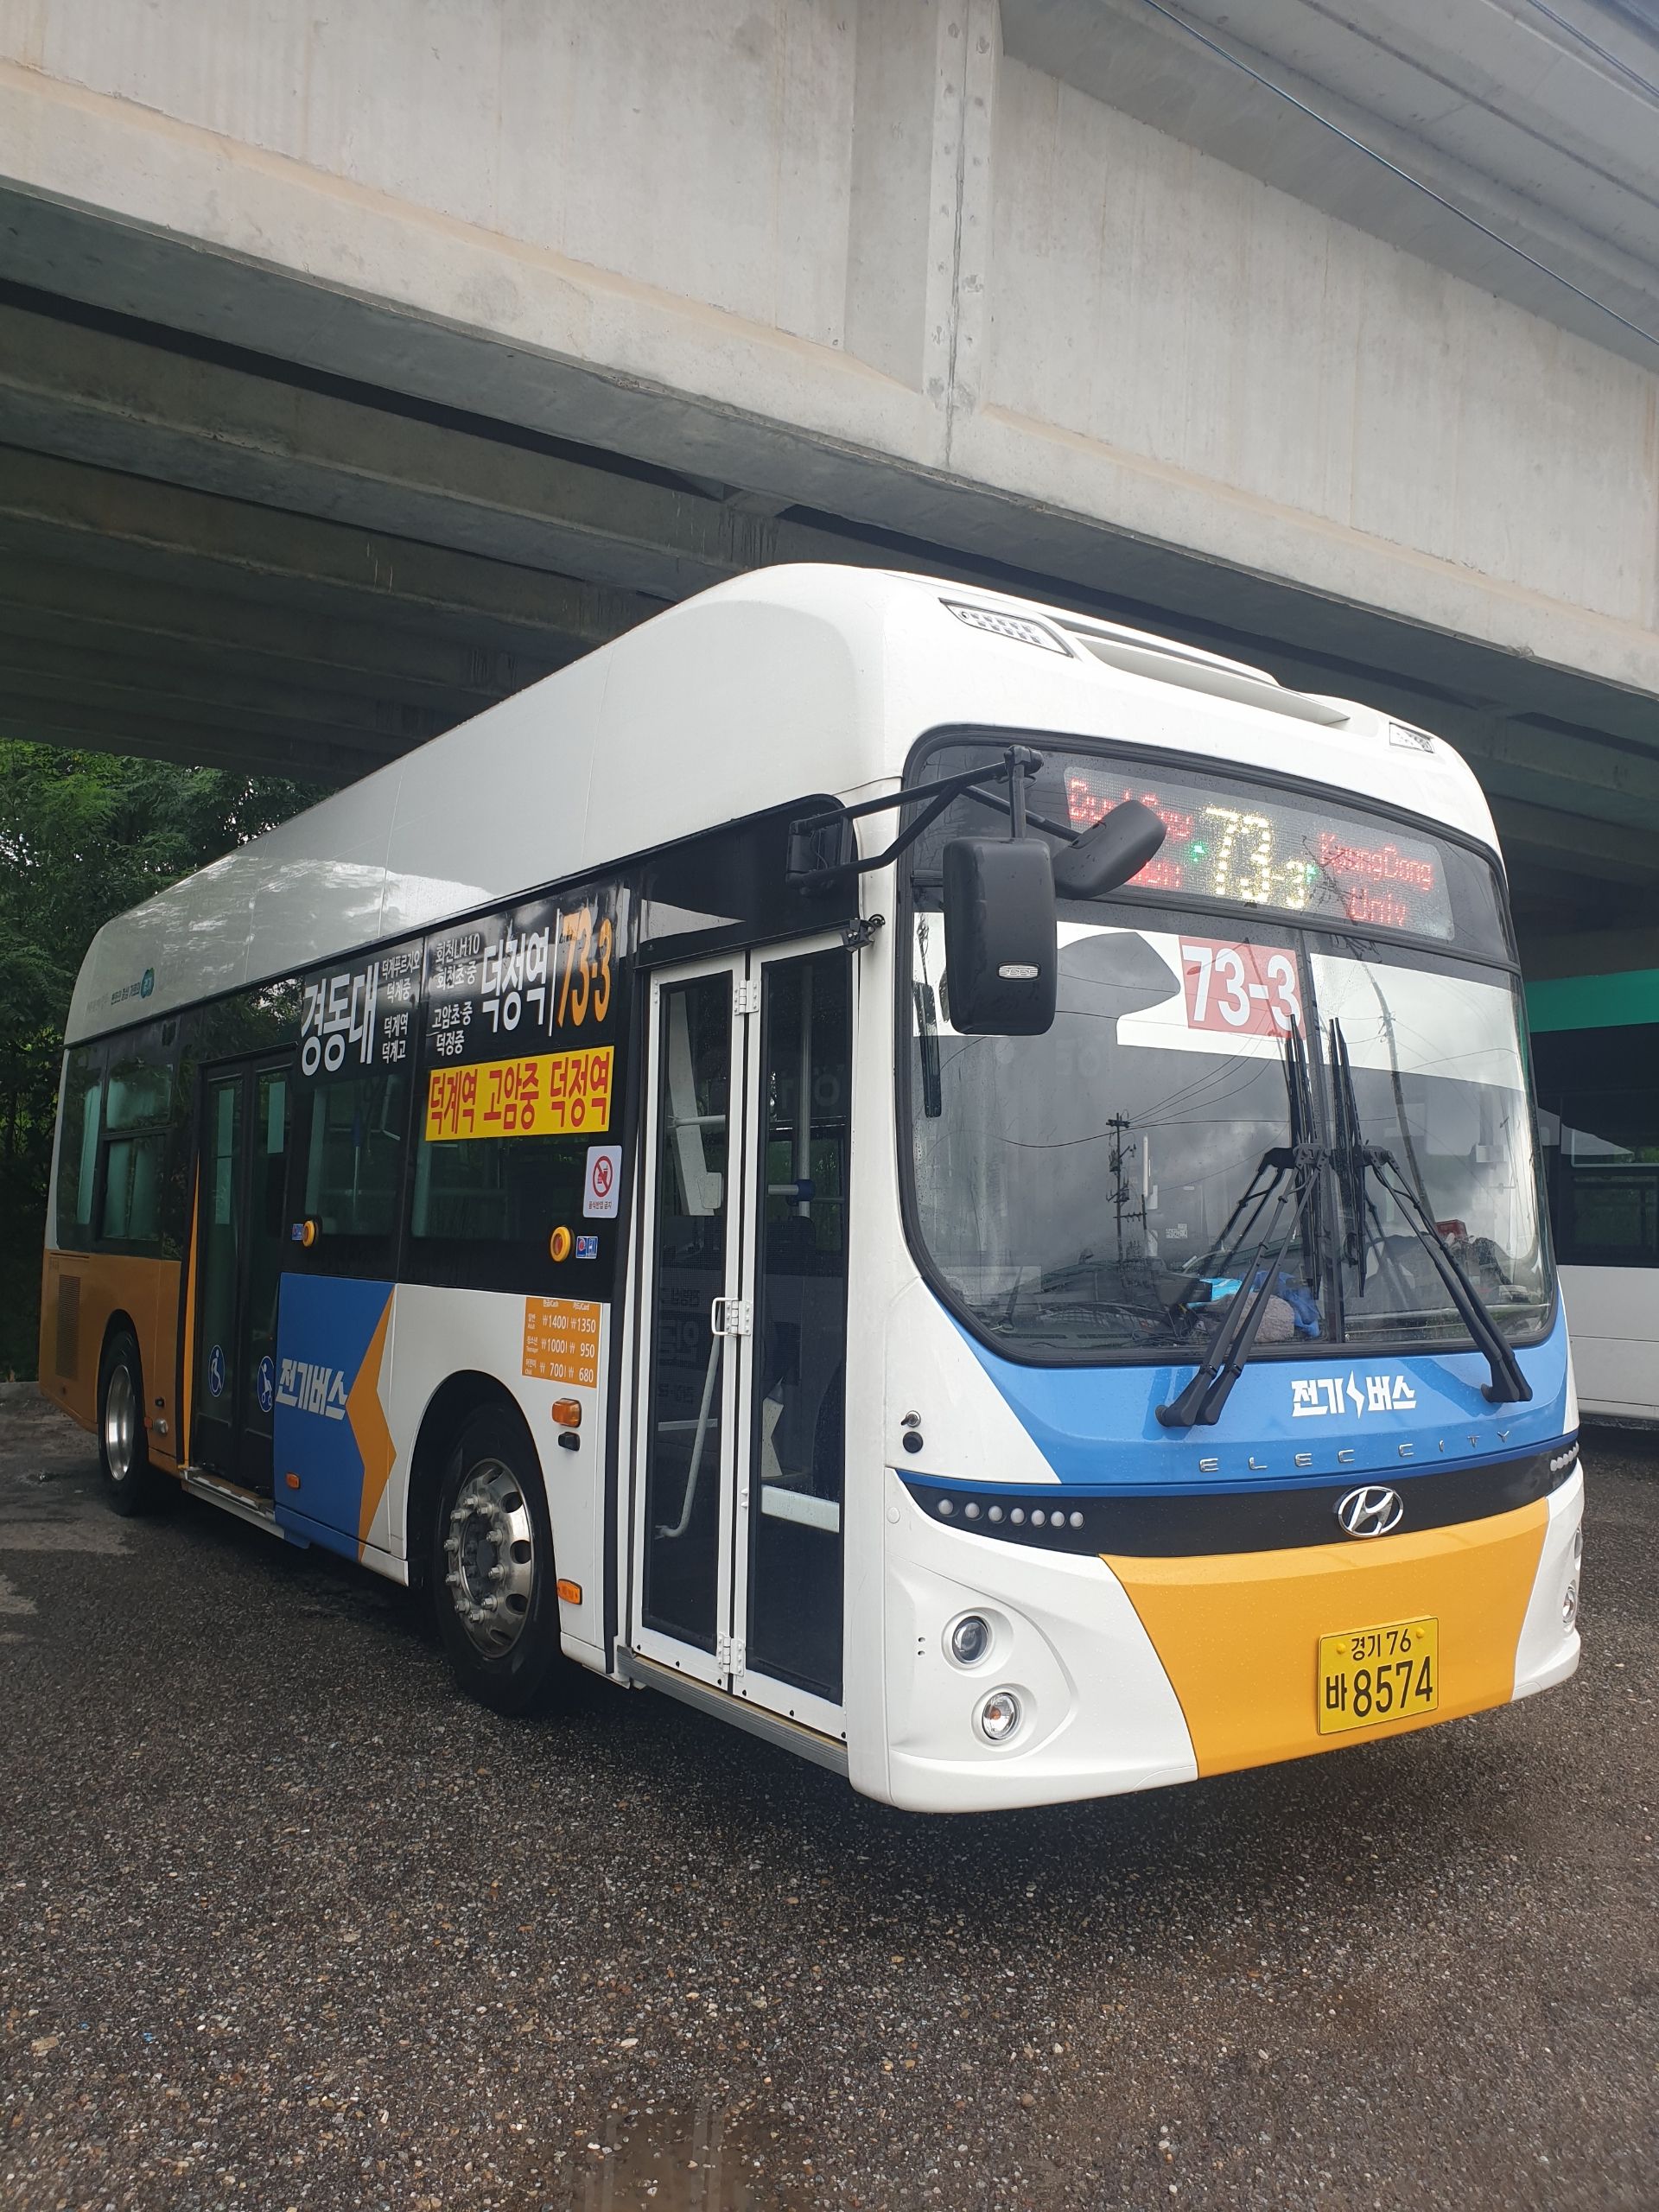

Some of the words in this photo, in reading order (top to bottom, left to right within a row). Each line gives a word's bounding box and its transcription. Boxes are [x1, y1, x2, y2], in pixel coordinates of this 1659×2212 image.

[382, 950, 421, 981] 덕계푸르지오
[481, 926, 550, 1033] 덕정역
[557, 907, 613, 1027] 73-3
[386, 977, 412, 1004] 덕계중
[1181, 944, 1301, 1032] 73-3
[301, 962, 380, 1077] 경동대
[384, 1012, 409, 1039] 덕계역
[381, 1039, 407, 1065] 덕계고
[435, 1029, 466, 1057] 덕정중
[430, 1068, 479, 1135] 덕계역
[483, 1062, 540, 1131] 고암중
[550, 1051, 610, 1128] 덕정역
[580, 1342, 595, 1358] 950
[550, 1362, 563, 1378] 700
[578, 1367, 594, 1383] 680
[276, 1357, 348, 1421] 전기버스
